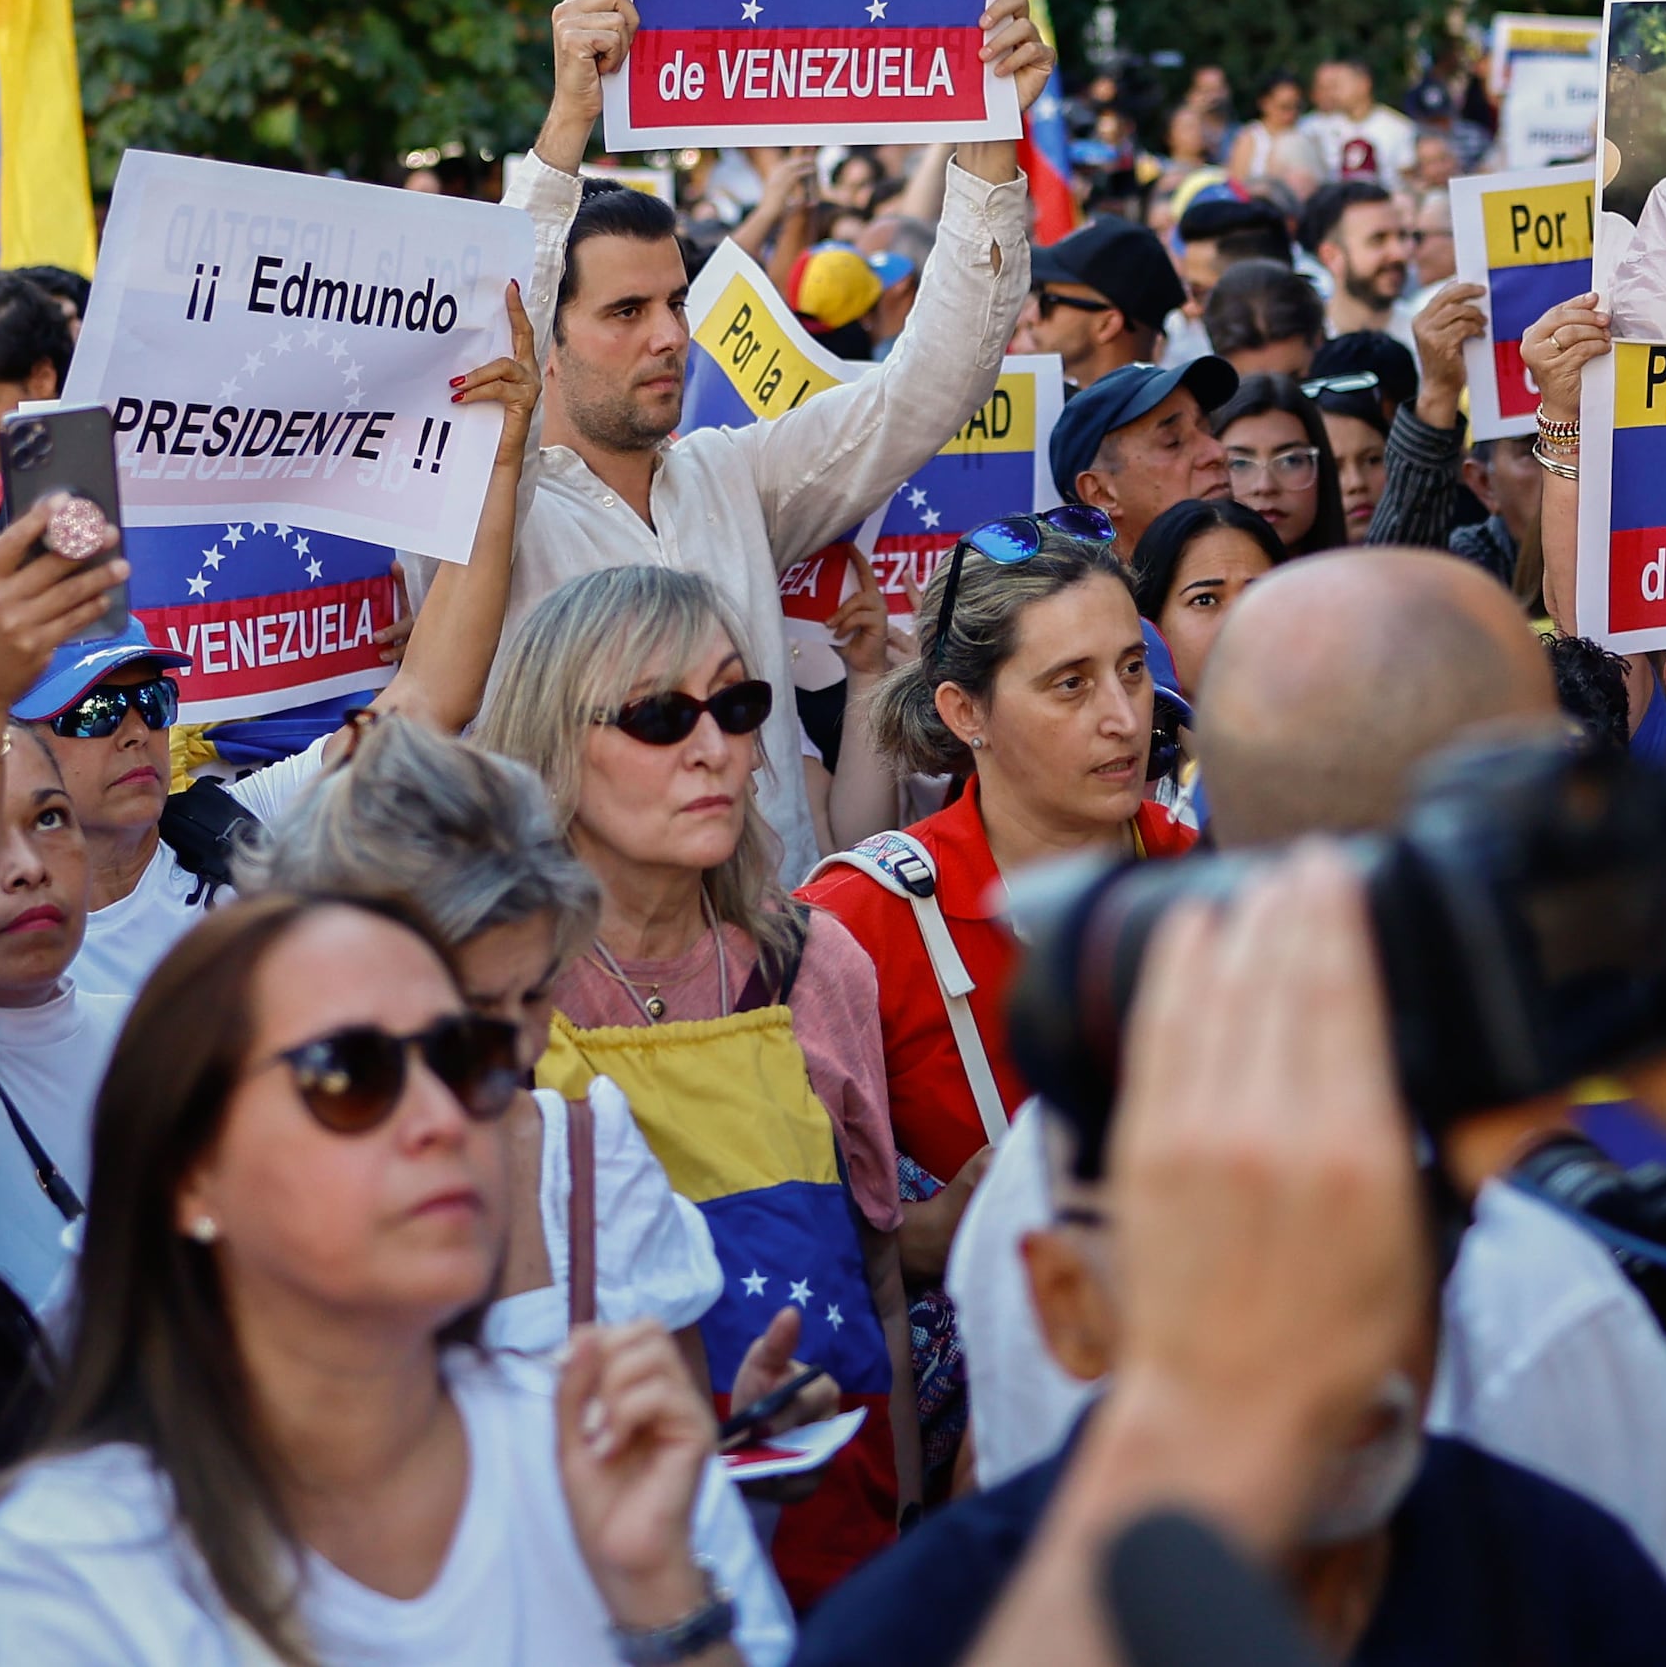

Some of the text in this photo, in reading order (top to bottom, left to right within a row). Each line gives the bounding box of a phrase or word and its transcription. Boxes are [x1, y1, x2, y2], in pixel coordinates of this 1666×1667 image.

[658, 47, 955, 101] de VENEZUELA
[1510, 203, 1567, 253] Por
[186, 255, 459, 335] ¡¡ Edmundo
[719, 302, 783, 408] Por la
[113, 397, 452, 475] PRESIDENTE !!
[954, 389, 1013, 440] AD
[167, 598, 375, 677] VENEZUELA
